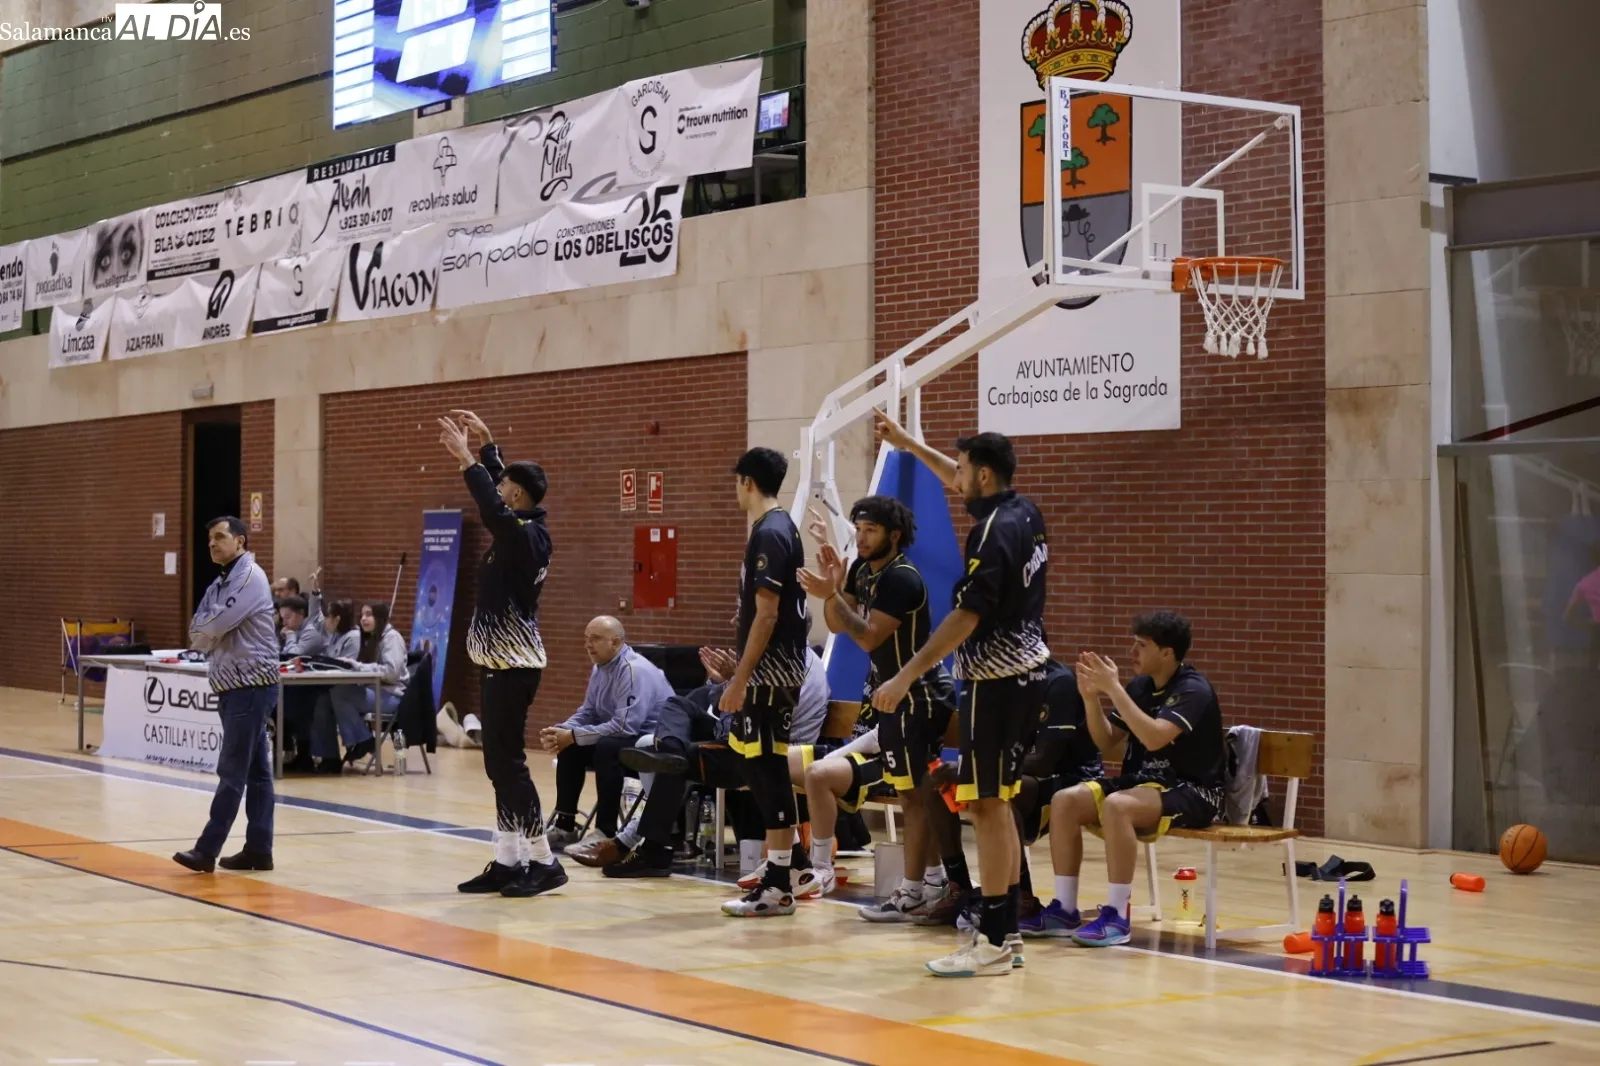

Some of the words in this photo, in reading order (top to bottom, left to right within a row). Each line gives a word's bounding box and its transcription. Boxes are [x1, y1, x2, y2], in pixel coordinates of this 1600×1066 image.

[631, 80, 671, 107] GARCISAN
[686, 114, 710, 128] trouw
[712, 106, 748, 124] nutrition
[1062, 114, 1070, 158] SPORT
[312, 149, 390, 180] RESTAURANTE
[452, 184, 478, 206] salud
[225, 201, 299, 239] TEBRIO
[359, 212, 370, 226] 30
[381, 206, 393, 222] 07
[556, 218, 616, 239] CONSTRUCCIONES
[442, 251, 483, 272] san
[485, 219, 549, 288] pablo
[554, 237, 582, 261] LOS
[585, 222, 674, 256] OBELISCOS
[348, 241, 436, 311] VIAGON
[1016, 352, 1135, 379] AYUNTAMIENTO
[987, 385, 1058, 409] Carbajosa
[1063, 381, 1081, 402] de
[1086, 380, 1099, 400] la
[1103, 375, 1168, 404] Sagrada
[968, 557, 981, 577] 7
[168, 687, 219, 712] LEXUS
[144, 723, 188, 749] CASTILLA
[188, 728, 195, 749] Y
[885, 750, 897, 769] 5
